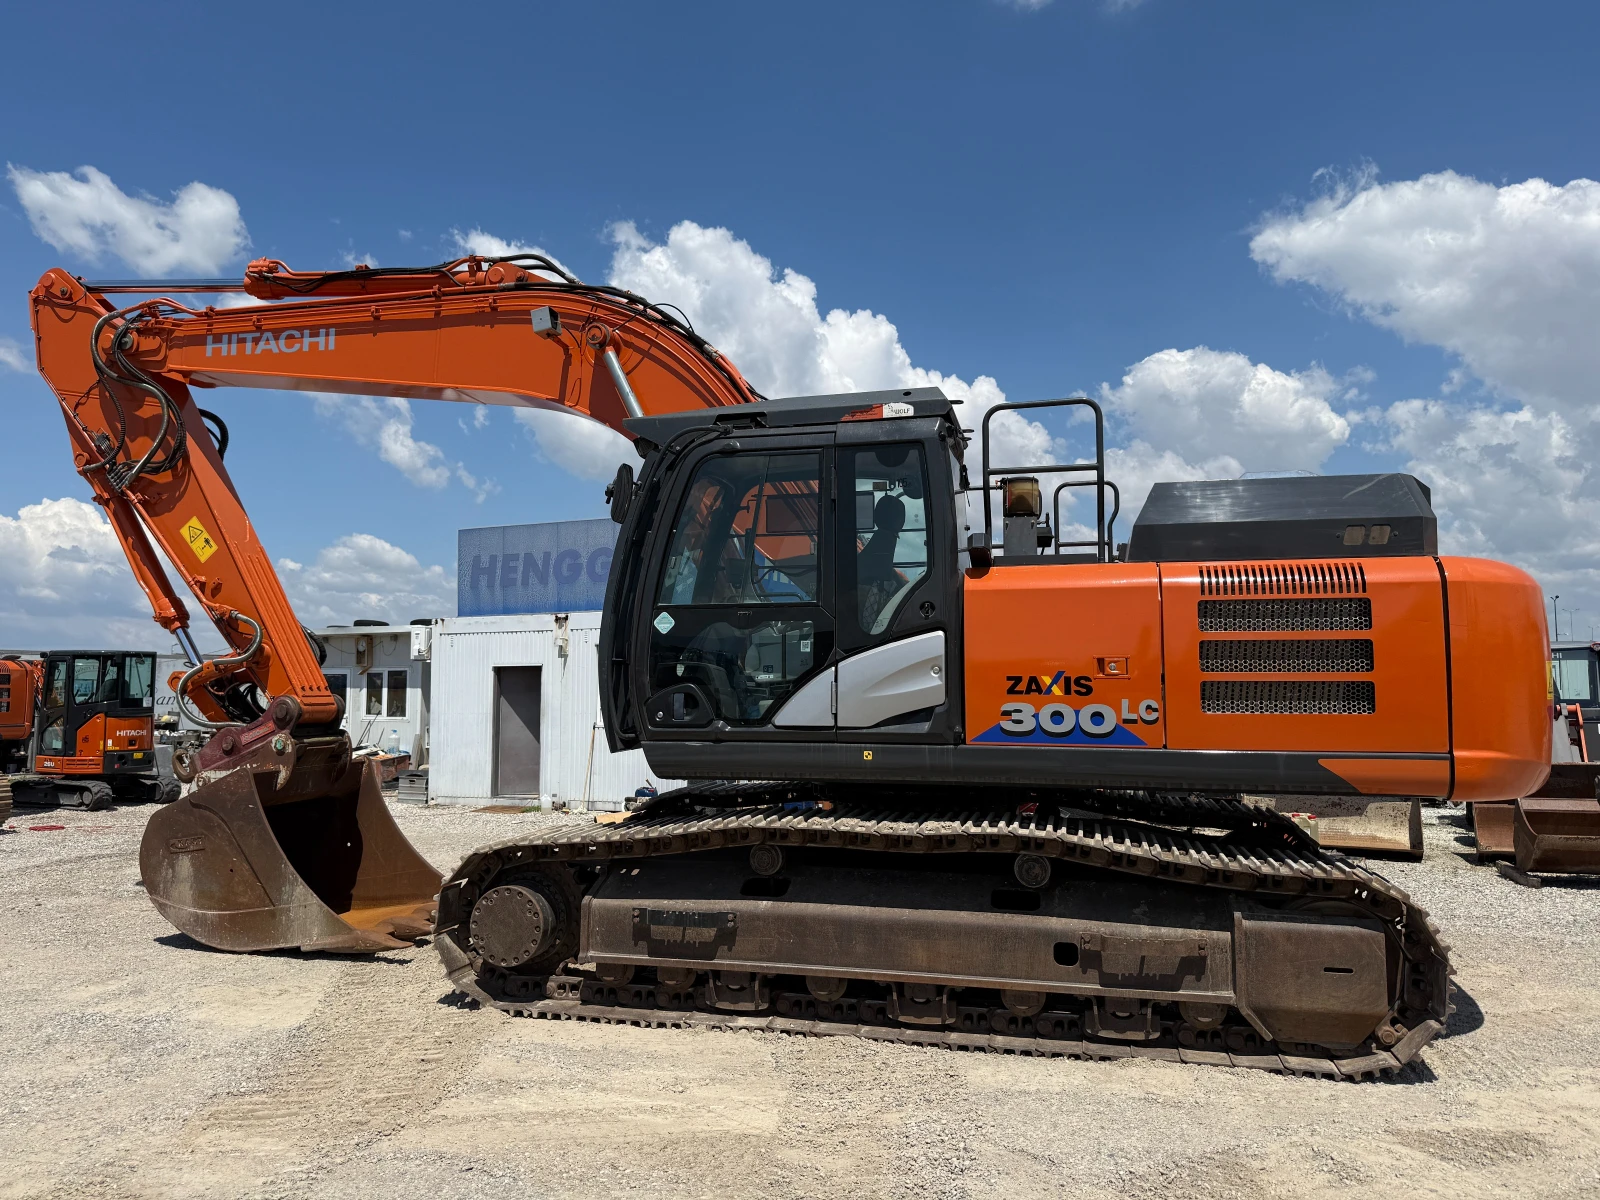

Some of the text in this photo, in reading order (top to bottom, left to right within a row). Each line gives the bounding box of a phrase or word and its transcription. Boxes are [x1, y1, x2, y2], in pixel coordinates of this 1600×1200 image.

[205, 328, 336, 357] HITACHI
[1006, 671, 1093, 696] ZAXIS
[1000, 699, 1159, 738] 300 LC
